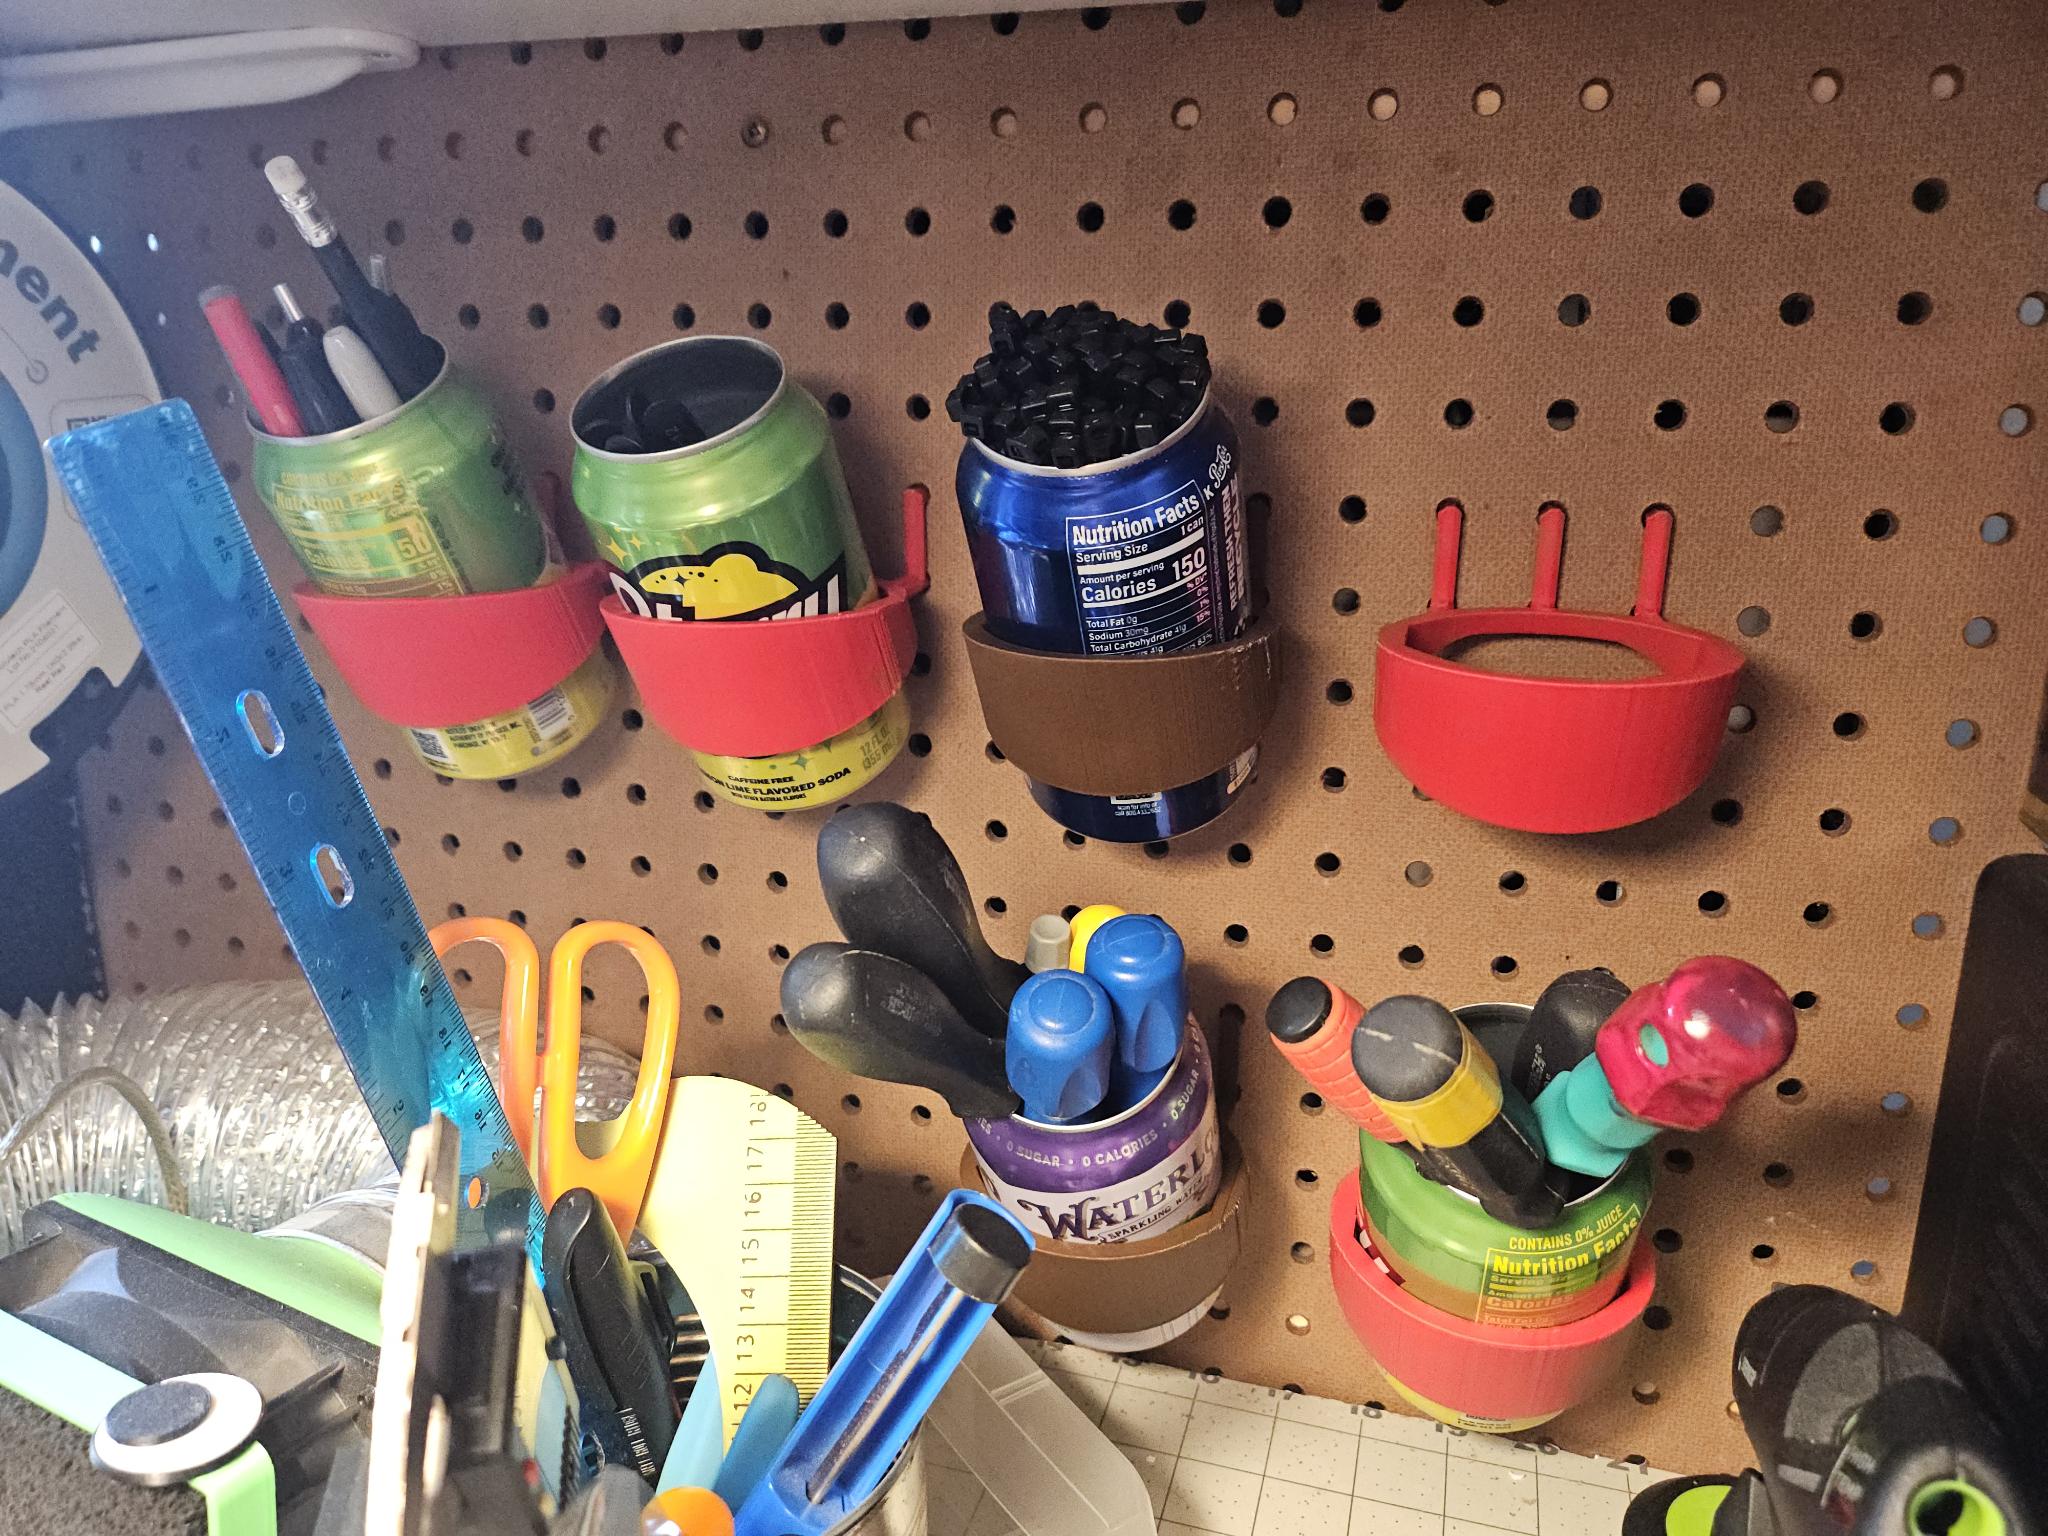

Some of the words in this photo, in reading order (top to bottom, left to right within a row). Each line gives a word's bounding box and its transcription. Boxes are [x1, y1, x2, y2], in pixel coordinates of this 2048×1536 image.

[1072, 515, 1154, 546] Nutrition
[1155, 493, 1201, 526] Facts
[1076, 548, 1122, 564] Serving
[1123, 542, 1148, 557] Size
[1187, 516, 1204, 533] can
[1079, 573, 1115, 585] Amount
[1115, 571, 1137, 584] per
[1136, 561, 1165, 580] serving
[1081, 577, 1157, 602] Calories
[1172, 546, 1206, 582] 150
[1086, 619, 1109, 629] Total
[1110, 617, 1125, 627] Fat
[1126, 615, 1138, 626] 0g
[1088, 630, 1123, 641] Sodium
[1090, 643, 1112, 653] Total
[1113, 630, 1173, 651] Carbohydrate
[753, 783, 816, 795] FLAVORED
[817, 767, 852, 786] SODA
[1016, 1146, 1061, 1168] SUGAR
[1082, 1156, 1092, 1168] 0
[1095, 1128, 1159, 1166] CALORIES
[1176, 1069, 1200, 1112] SUGAR
[746, 1146, 764, 1171] 17
[744, 1190, 762, 1217] 16
[1108, 1205, 1172, 1241] SPARKLING
[1509, 1232, 1573, 1251] CONTAINS
[1574, 1225, 1595, 1243] 0%
[1595, 1203, 1625, 1235] JUICE
[741, 1238, 760, 1265] 15
[1492, 1252, 1590, 1277] Nutrition
[1592, 1218, 1639, 1260] Facts
[739, 1286, 756, 1313] 14
[736, 1334, 755, 1361] 13
[732, 1382, 753, 1411] 12
